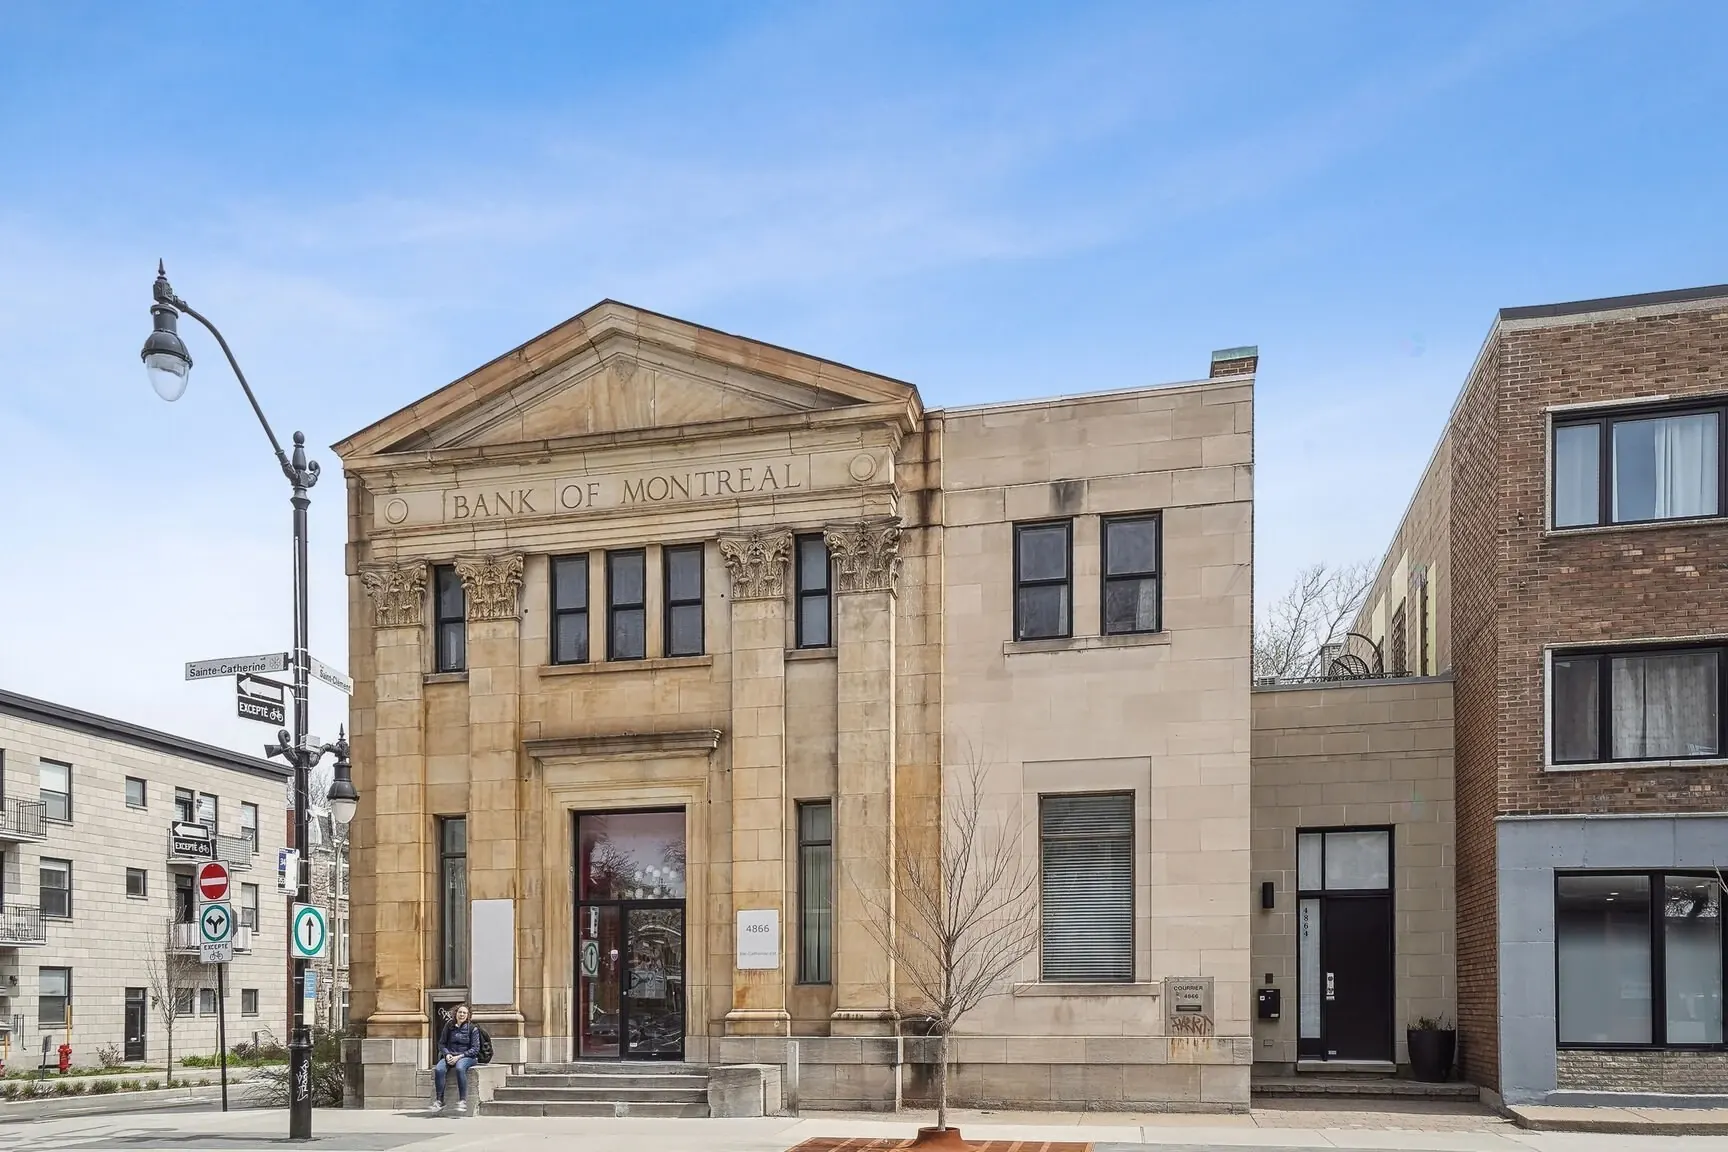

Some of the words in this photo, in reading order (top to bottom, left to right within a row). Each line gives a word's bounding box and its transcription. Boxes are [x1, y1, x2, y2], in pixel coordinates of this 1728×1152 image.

[453, 488, 536, 519] BANK
[561, 483, 600, 509] OF
[621, 463, 801, 504] MONTREAL
[189, 662, 266, 677] Sainte-Catherine
[240, 702, 269, 718] EXCEPTÉ
[746, 924, 770, 933] 4866
